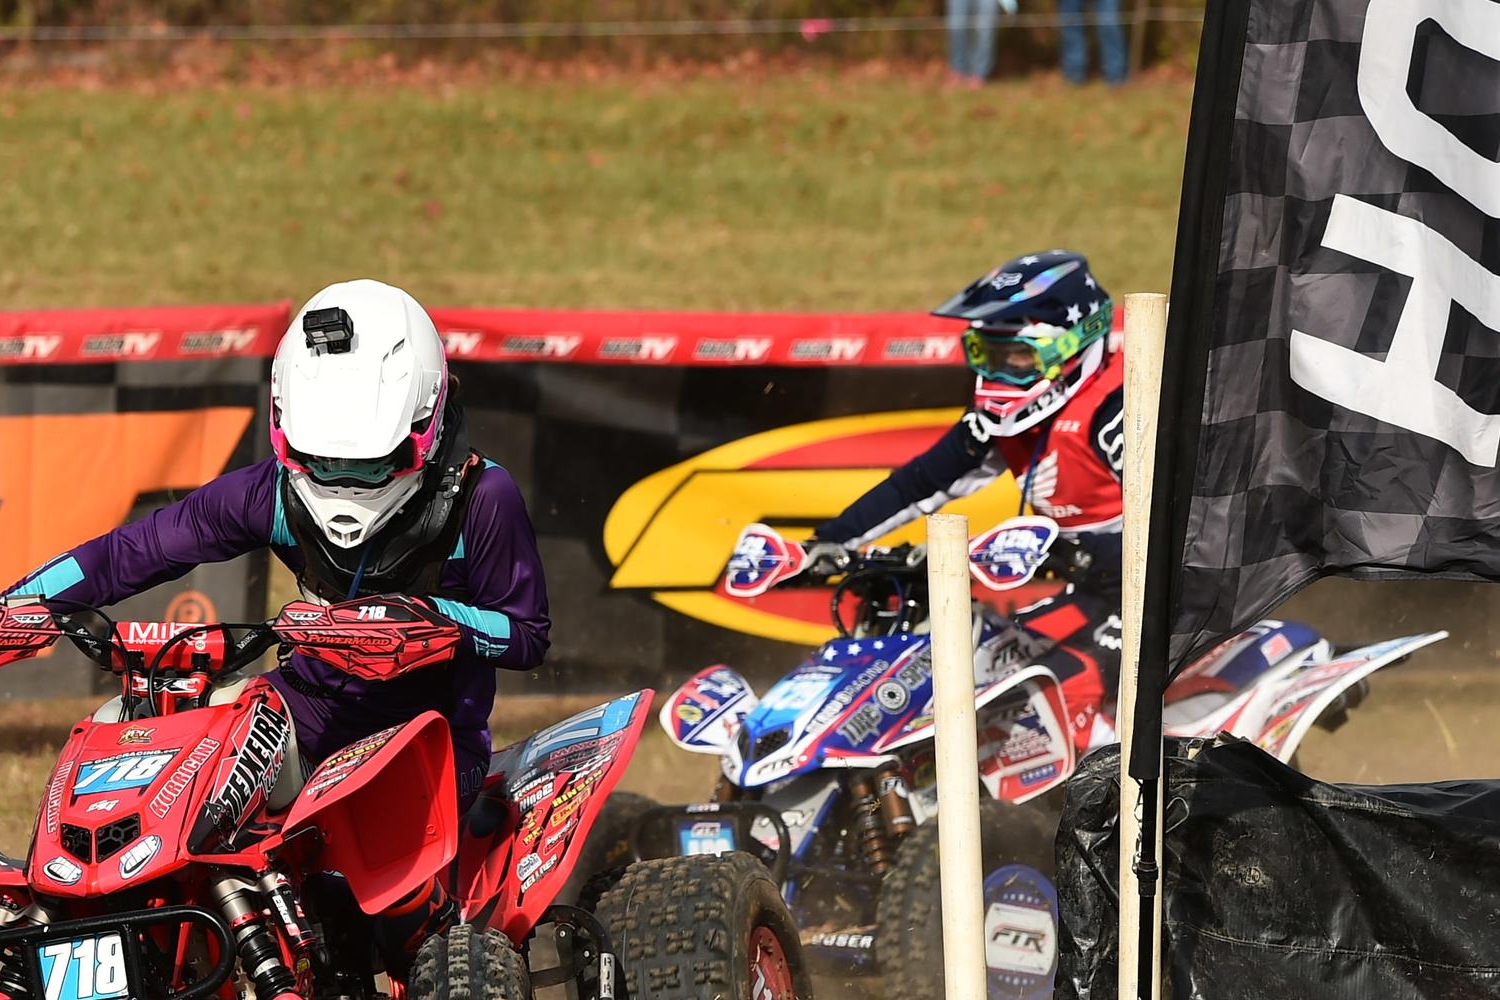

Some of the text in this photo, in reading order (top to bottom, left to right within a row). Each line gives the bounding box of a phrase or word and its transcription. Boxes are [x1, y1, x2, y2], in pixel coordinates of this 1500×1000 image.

[357, 606, 386, 619] 718
[73, 754, 175, 789] 718
[149, 737, 221, 818] HURRICANE
[219, 702, 289, 824] TEIXEIRA
